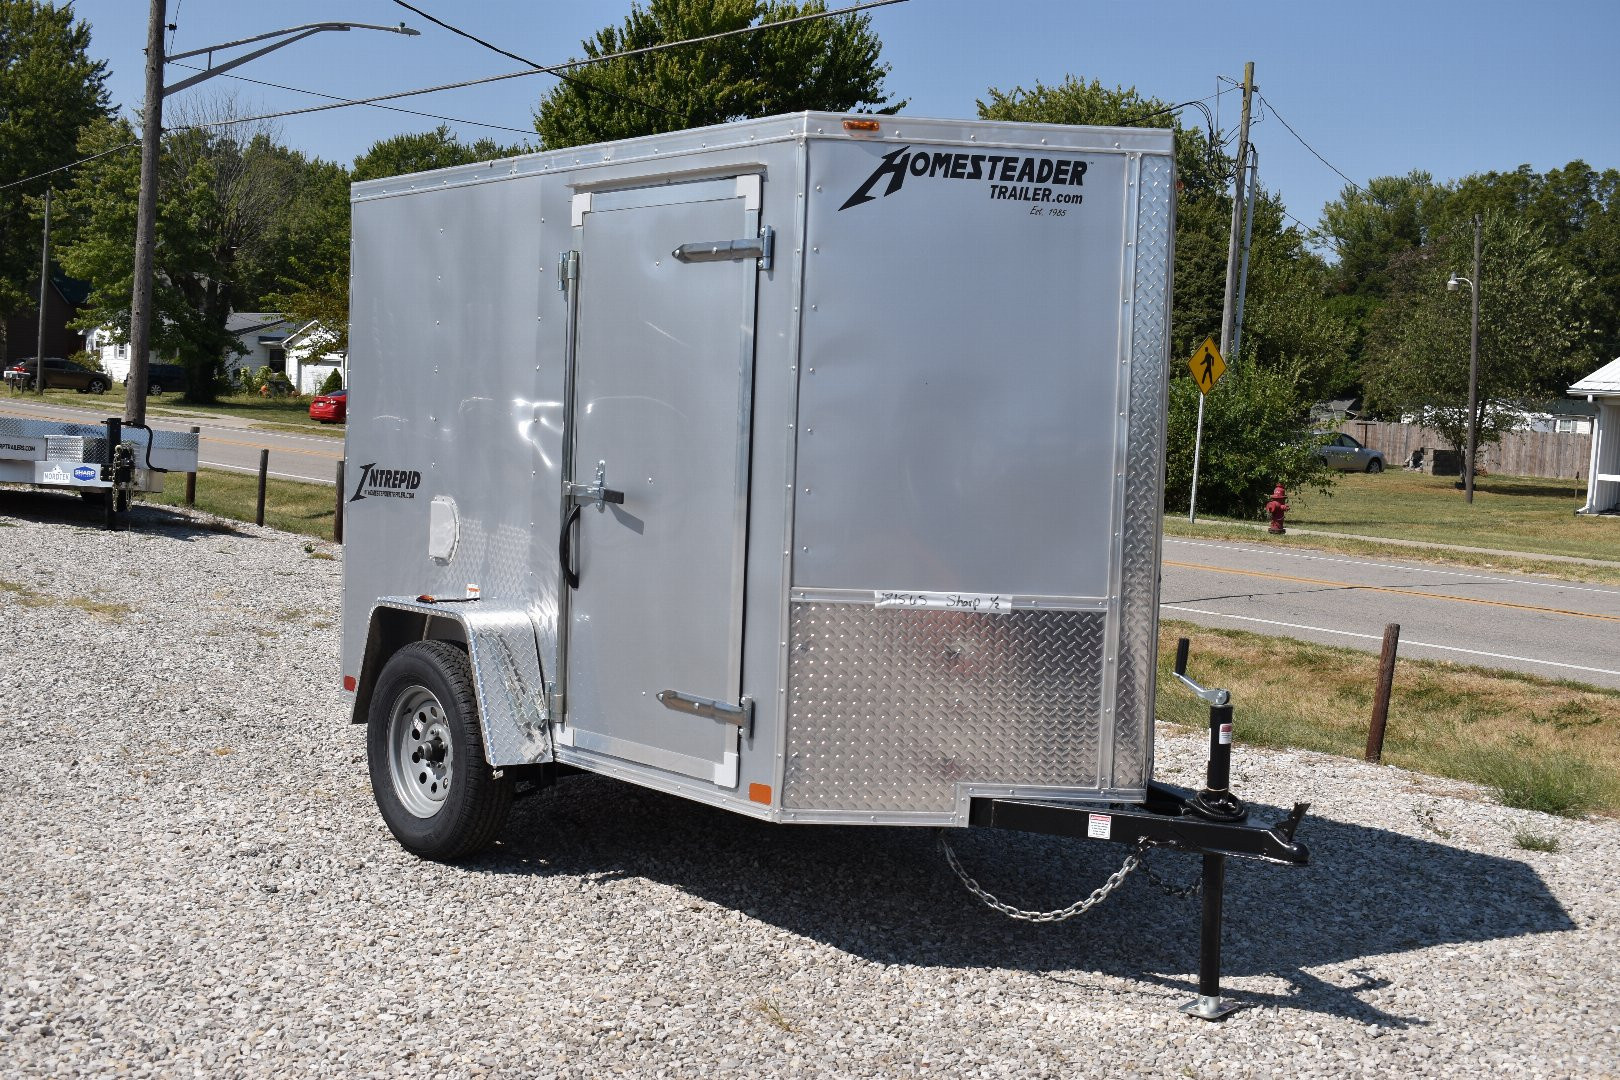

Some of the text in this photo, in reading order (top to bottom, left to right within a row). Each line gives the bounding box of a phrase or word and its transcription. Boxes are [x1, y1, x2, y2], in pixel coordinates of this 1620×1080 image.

[838, 145, 1088, 211] HOMESTEADER
[990, 184, 1083, 205] TRAILER.com
[1048, 208, 1068, 217] 1985
[349, 462, 422, 502] INTREPID
